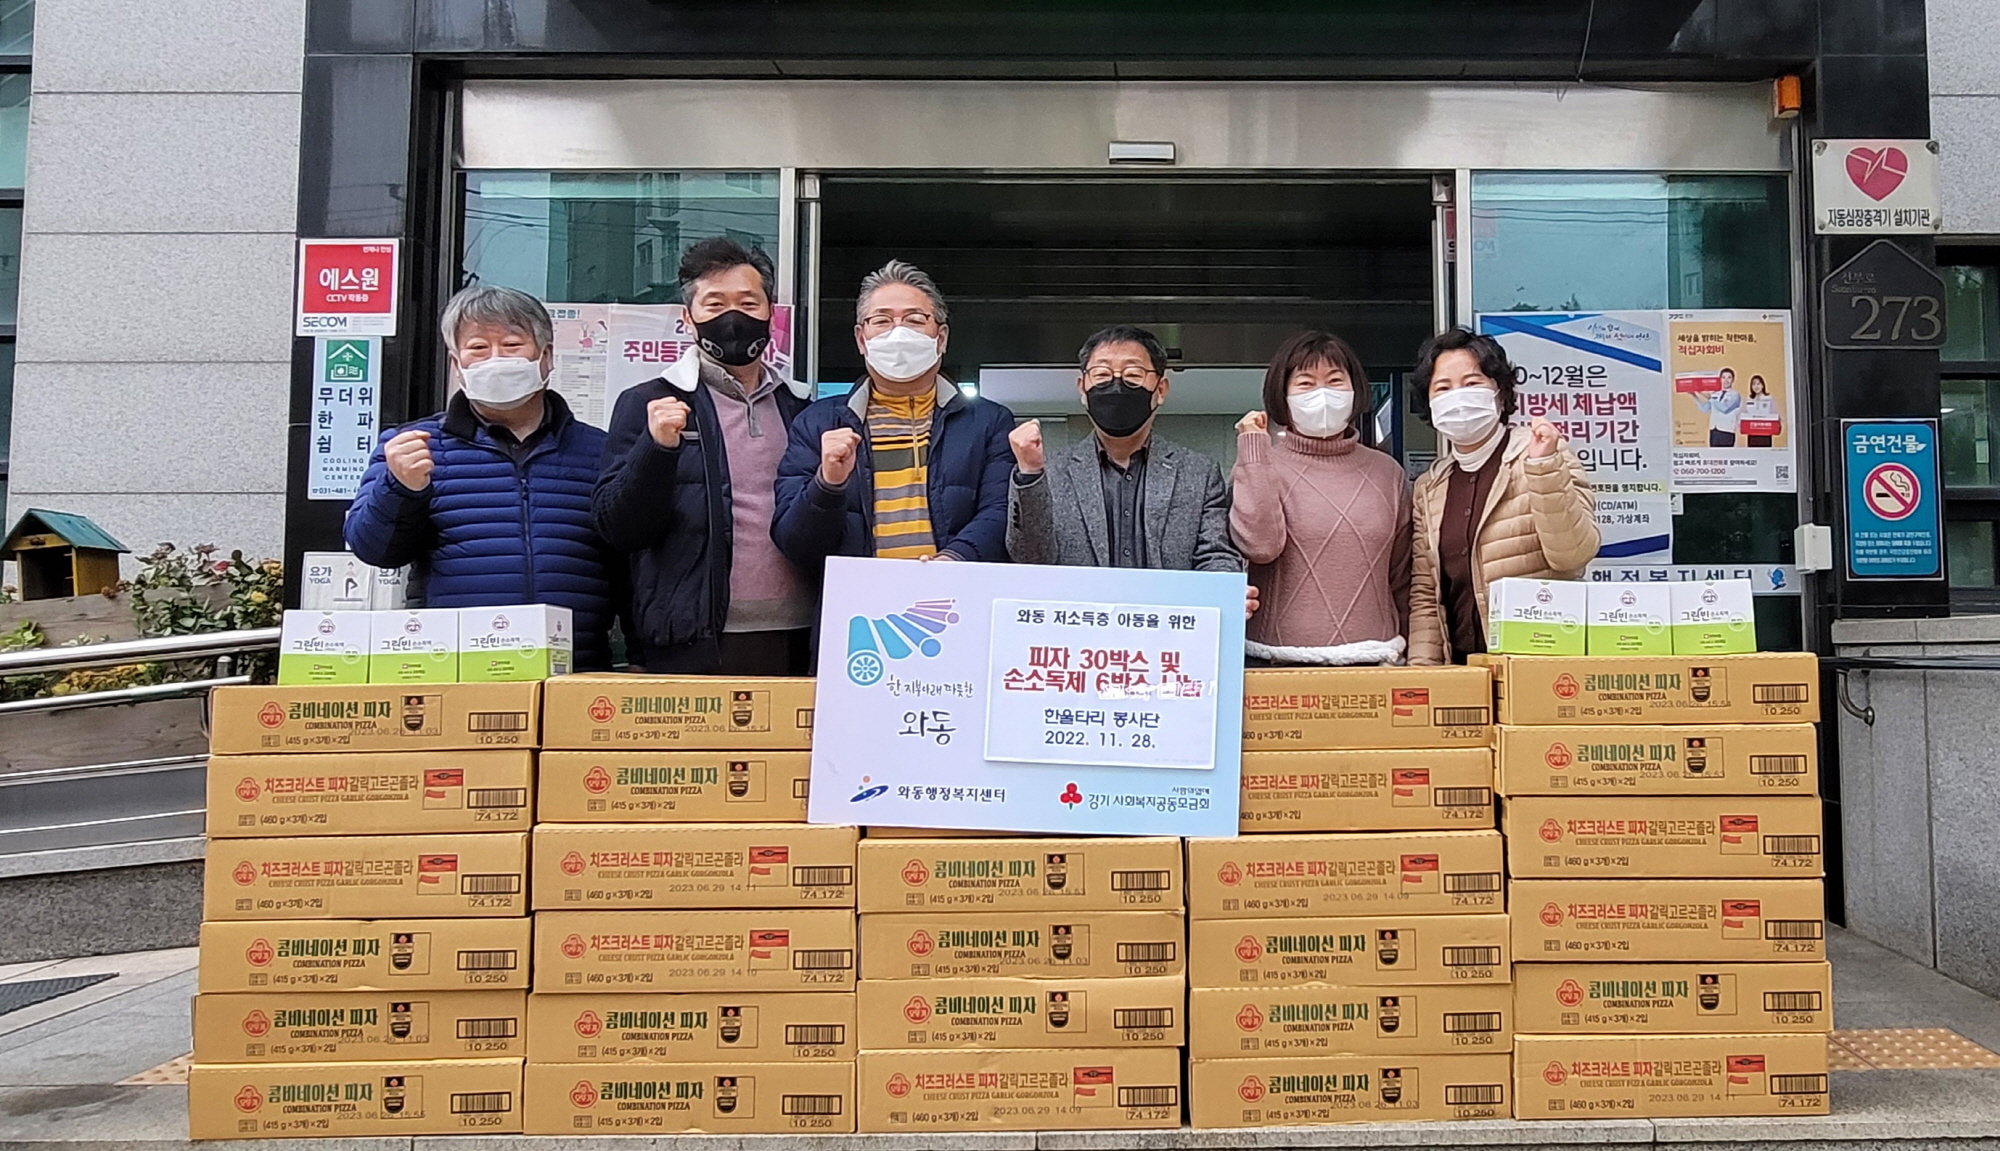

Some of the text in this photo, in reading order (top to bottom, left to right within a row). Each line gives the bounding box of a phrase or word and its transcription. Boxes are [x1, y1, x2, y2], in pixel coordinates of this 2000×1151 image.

[1828, 209, 1930, 227] 자동심장충격기 설치기관
[319, 268, 379, 291] 에스원
[326, 294, 347, 302] CCTV
[303, 317, 347, 327] SECOM
[1851, 295, 1941, 340] 273
[1678, 345, 1725, 355] 적십자회비
[1515, 365, 1608, 388] 0~12월은
[1573, 392, 1637, 416] 체납액
[1595, 420, 1639, 443] 기간
[1852, 434, 1920, 454] 금연건물
[1577, 448, 1647, 472] 입니다.
[309, 566, 332, 577] 요가
[309, 577, 332, 585] YOGA
[1017, 609, 1196, 630] 와동 저소득층 아동을 위한
[1513, 605, 1542, 620] 그린빈
[1598, 608, 1628, 623] 그린빈
[1681, 607, 1710, 622] 그린빈
[293, 637, 324, 651] 그린빈
[381, 636, 411, 651] 그린빈
[470, 633, 500, 648] 그린빈
[1028, 646, 1180, 673] 피자 30박스 및
[886, 674, 901, 696] 한
[944, 681, 973, 698] 따뜻한
[1003, 668, 1086, 693] 손소독제
[1584, 674, 1681, 691] 콤비네이션 피자
[620, 697, 722, 714] 콤비네이션 피자
[1243, 695, 1299, 710] 치즈크러스트
[1598, 693, 1644, 701] COMBINATION
[288, 701, 392, 719] 콤비네이션 피자
[1044, 708, 1160, 728] 한울타리 봉사단
[685, 716, 706, 724] PIZZA
[899, 711, 957, 745] 와동
[1045, 731, 1155, 749] 2022. 11. 28.
[1577, 745, 1676, 762] 콤비네이션 피자
[616, 767, 718, 785] 콤비네이션 피자
[1240, 775, 1298, 790] 치즈크러스트
[264, 777, 325, 793] 치즈크러스트
[897, 786, 1005, 802] 와동행정복지센터
[1567, 821, 1625, 835] 치즈크러스트
[590, 852, 650, 867] 치즈크러스트
[261, 862, 321, 877] 치즈크러스트
[646, 870, 664, 878] PIZZA
[934, 860, 1036, 878] 콤비네이션 피자
[1246, 862, 1305, 877] 치즈크러스트
[1568, 905, 1626, 919] 치즈크러스트
[277, 938, 380, 957] 콤비네이션 피자
[590, 935, 650, 951] 치즈크러스트
[938, 930, 1039, 948] 콤비네이션 피자
[1266, 935, 1366, 953] 콤비네이션 피자
[293, 959, 365, 968] COMBINATION PIZZA
[1589, 980, 1688, 998] 콤비네이션 피자
[934, 996, 1036, 1014] 콤비네이션 피자
[1269, 1003, 1369, 1022] 콤비네이션 피자
[274, 1009, 377, 1027] 콤비네이션 피자
[605, 1011, 708, 1029] 콤비네이션 피자
[951, 1017, 1023, 1026] COMBINATION PIZZA
[1571, 1062, 1630, 1077] 치즈크러스트
[915, 1074, 975, 1089] 치즈크러스트
[1269, 1075, 1369, 1093] 콤비네이션 피자
[268, 1084, 373, 1103] 콤비네이션 피자
[600, 1081, 704, 1100] 콤비네이션 피자
